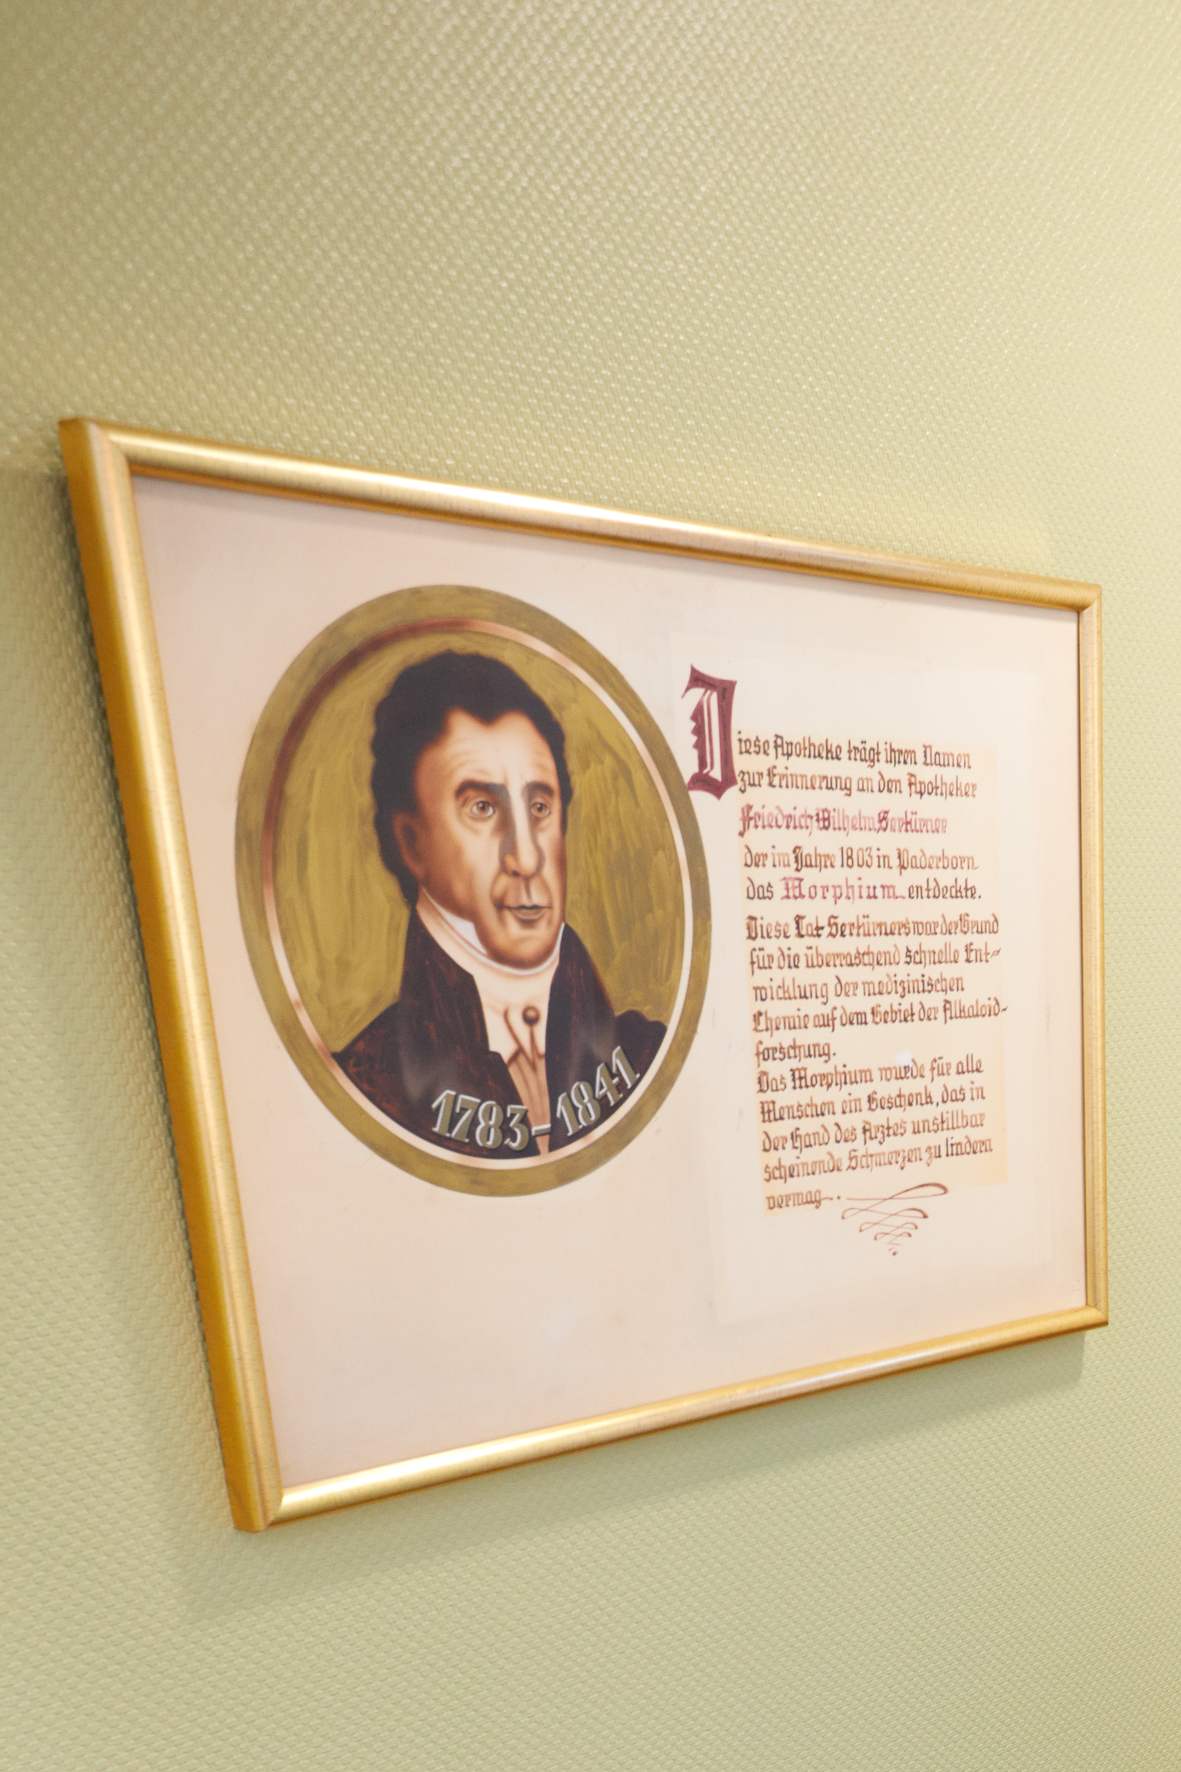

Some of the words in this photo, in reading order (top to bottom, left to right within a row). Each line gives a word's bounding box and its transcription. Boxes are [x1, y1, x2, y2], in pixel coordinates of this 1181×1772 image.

[773, 734, 842, 761] Apotheke
[847, 739, 881, 768] trägt
[884, 741, 918, 767] ihren
[922, 743, 972, 769] Namen
[738, 769, 764, 793] zur
[767, 765, 852, 796] Erinnerung
[856, 776, 875, 793] an
[878, 770, 903, 794] den
[906, 772, 977, 800] Apotheker
[738, 803, 814, 837] Friedrich
[815, 807, 876, 837] Wilhelm
[876, 809, 947, 834] Sertürner
[744, 844, 768, 868] der
[771, 845, 791, 868] im
[792, 845, 836, 872] Jahre
[840, 846, 873, 869] 1803
[876, 847, 893, 869] in
[896, 847, 979, 876] Paderborn
[746, 876, 774, 900] das
[780, 876, 905, 905] Morphium
[908, 877, 982, 899] entdeckte.
[745, 914, 792, 940] Diese
[794, 914, 824, 938] Tat
[826, 913, 911, 938] Sertürners
[912, 919, 940, 936] war
[940, 913, 959, 936] der
[959, 912, 999, 936] Grund
[750, 946, 774, 977] für
[777, 946, 800, 970] die
[804, 943, 901, 971] überraschend
[904, 942, 960, 968] schnelle
[753, 977, 829, 1005] wicklung
[833, 975, 858, 998] der
[861, 971, 965, 998] medizinischen
[752, 1008, 810, 1038] Chemie
[812, 1006, 837, 1033] auf
[840, 1005, 868, 1026] dem
[871, 1002, 916, 1025] Gebiet
[918, 1000, 939, 1022] der
[755, 1037, 837, 1069] forschung.
[757, 1070, 787, 1094] Das
[789, 1064, 874, 1092] Morphium
[878, 1058, 926, 1082] wurde
[929, 1056, 952, 1083] für
[955, 1053, 985, 1076] alle
[759, 1095, 836, 1124] Menschen
[841, 1092, 863, 1115] ein
[867, 1086, 940, 1112] Geschenk,
[941, 1083, 966, 1105] das
[969, 1080, 987, 1102] in
[762, 1130, 788, 1153] der
[790, 1123, 831, 1154] Hand
[834, 1121, 858, 1144] des
[862, 1116, 907, 1145] Arztes
[911, 1108, 986, 1136] unstillbar
[763, 1151, 843, 1185] scheinende
[845, 1147, 923, 1172] Schmerzen
[925, 1142, 942, 1168] zu
[945, 1134, 994, 1158] lindern
